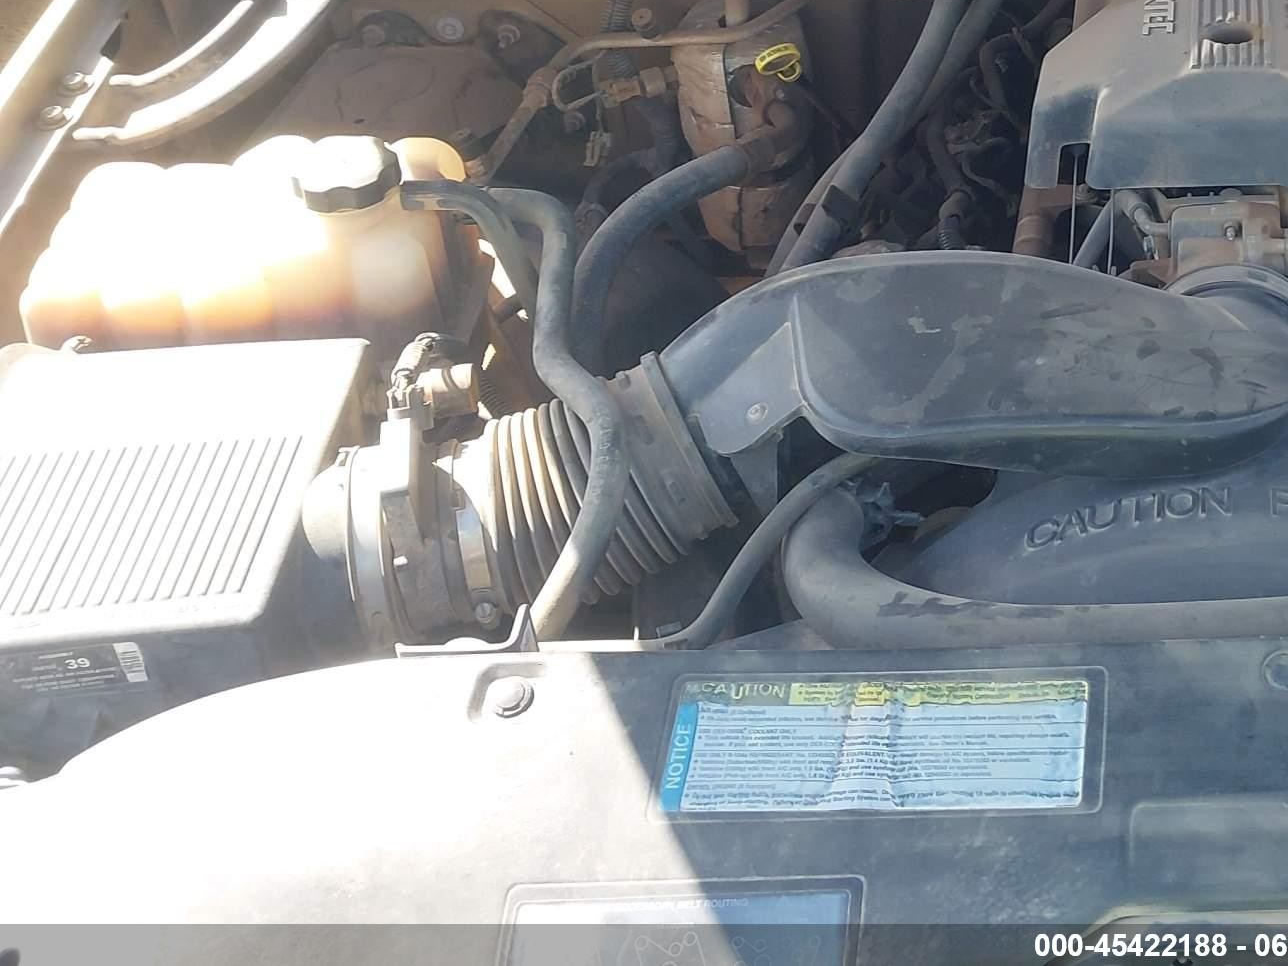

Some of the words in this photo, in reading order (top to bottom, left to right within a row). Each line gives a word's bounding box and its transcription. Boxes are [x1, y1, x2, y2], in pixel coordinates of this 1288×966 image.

[1024, 486, 1233, 552] CAUTION
[63, 657, 91, 669] 39
[701, 682, 785, 700] CAUTION
[665, 723, 691, 789] NOTICE
